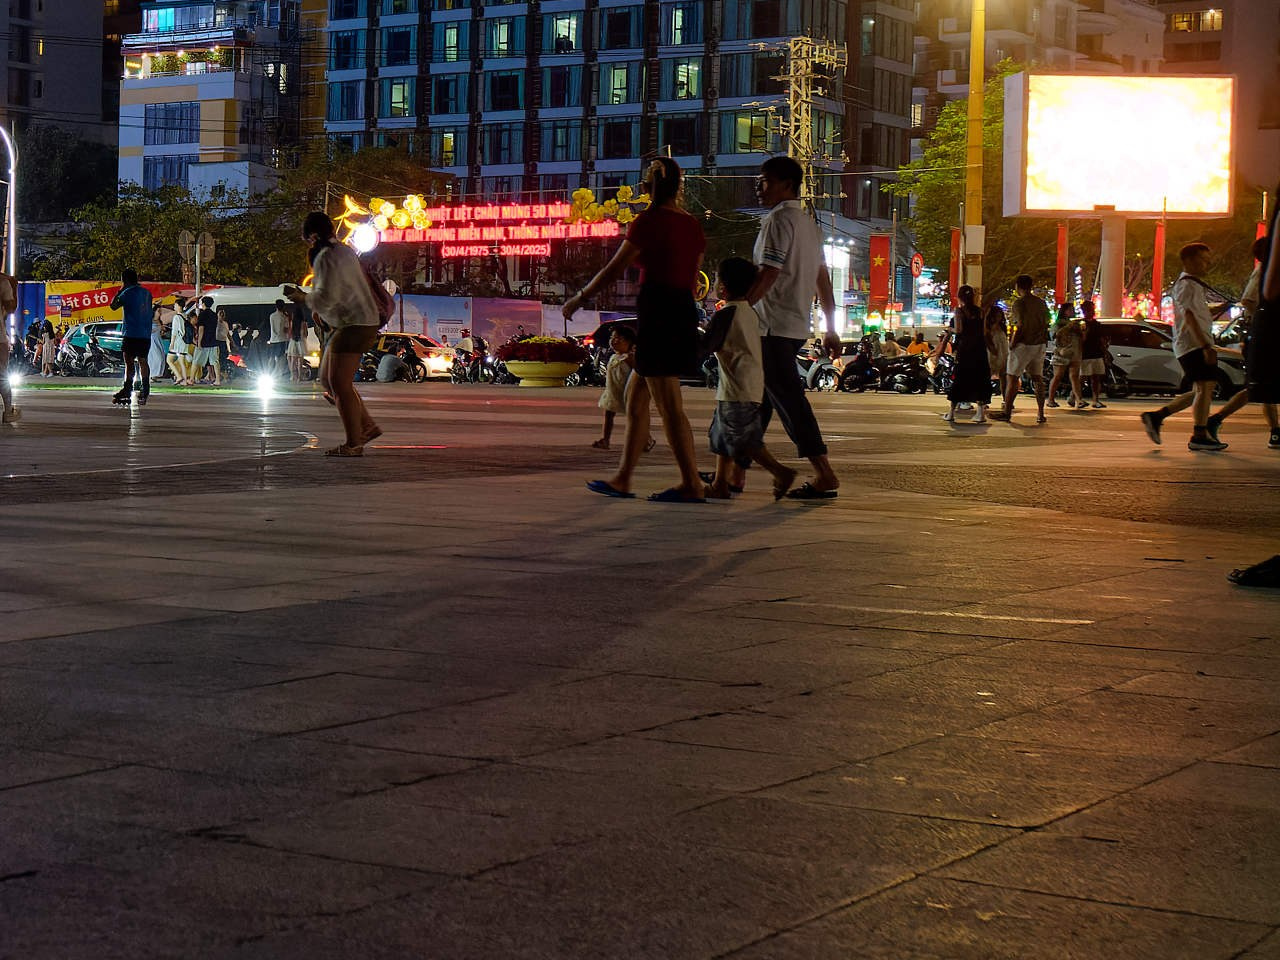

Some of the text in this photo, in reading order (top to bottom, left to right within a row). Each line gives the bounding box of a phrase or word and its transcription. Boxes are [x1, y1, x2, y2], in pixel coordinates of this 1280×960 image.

[474, 203, 499, 220] CHÀO
[532, 205, 546, 219] 50
[441, 244, 489, 259] (30/4/1975
[500, 243, 551, 257] 30/4/2025)
[93, 291, 109, 305] tô
